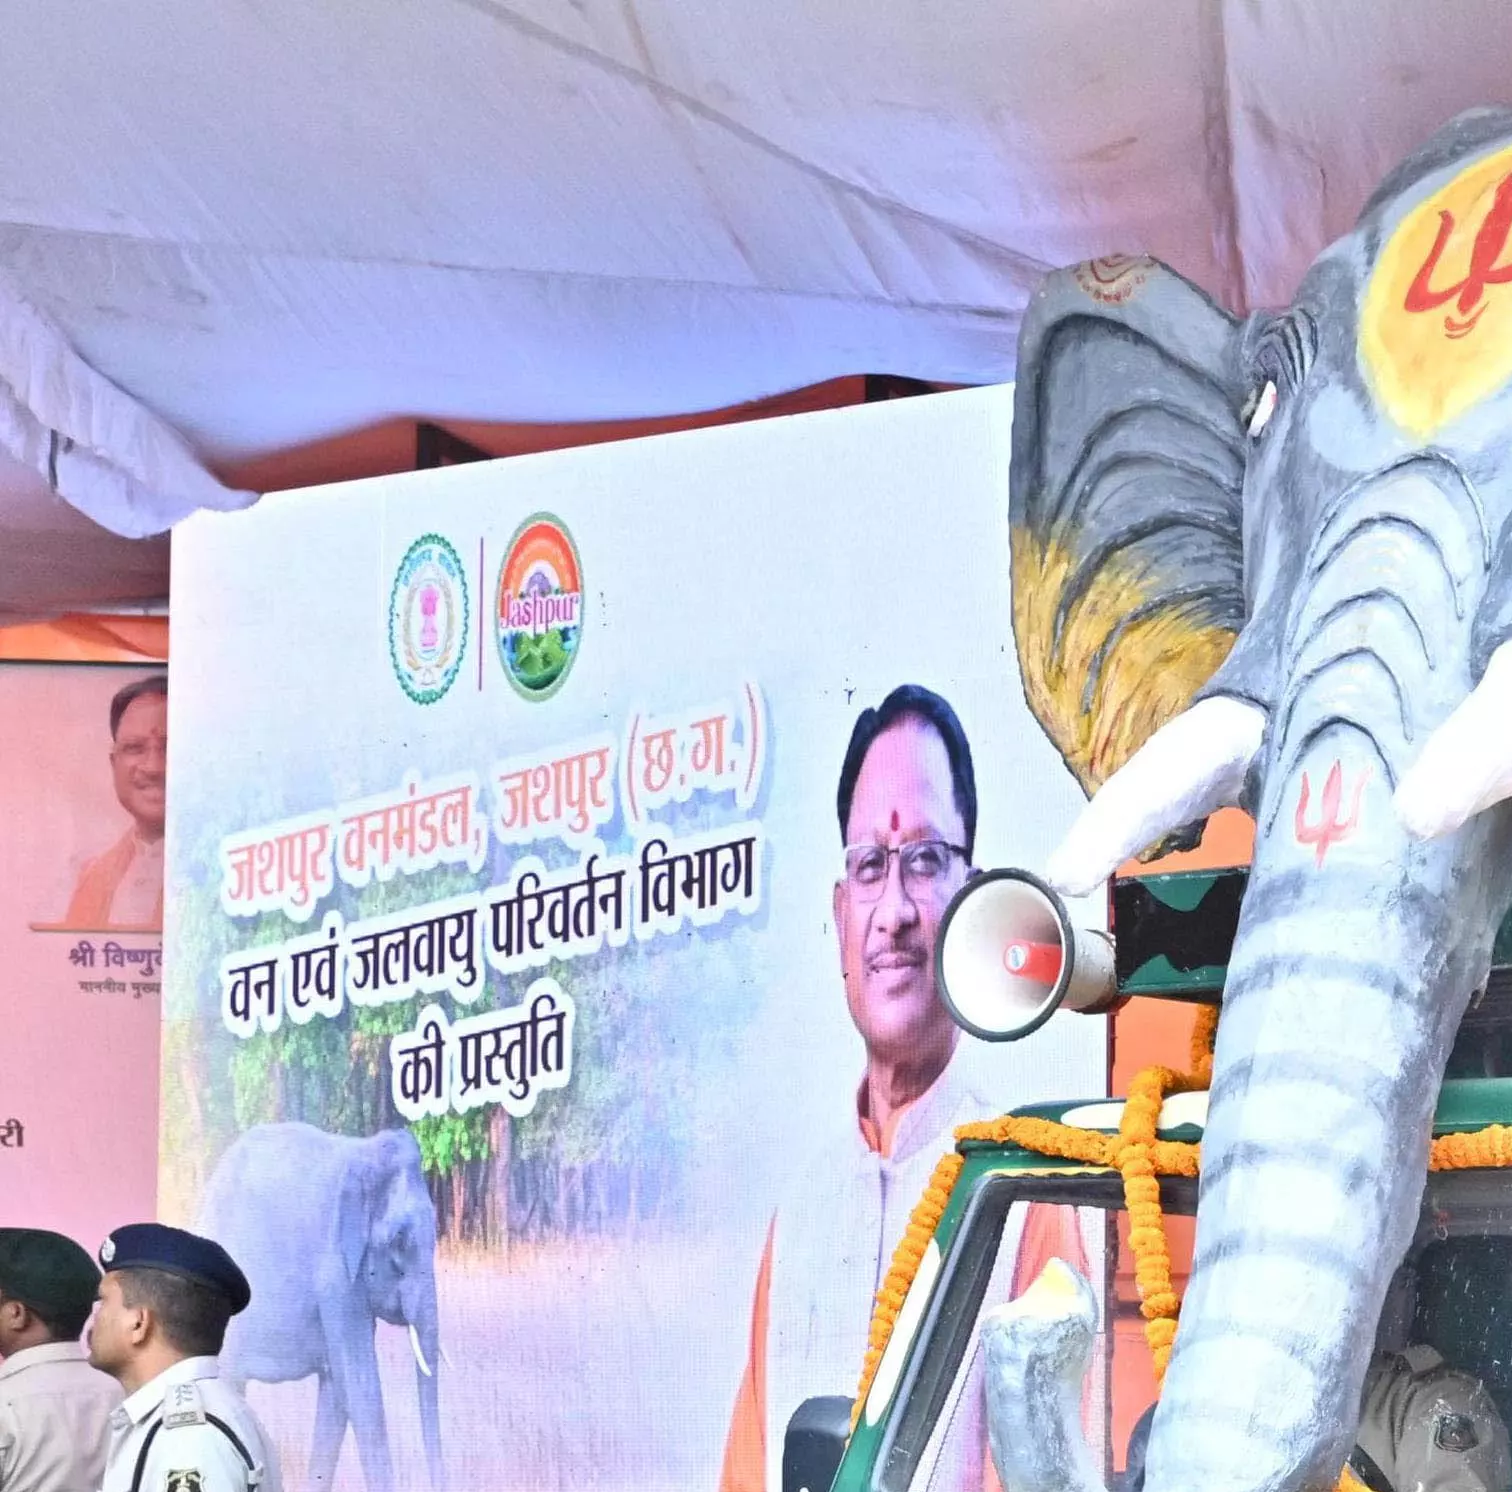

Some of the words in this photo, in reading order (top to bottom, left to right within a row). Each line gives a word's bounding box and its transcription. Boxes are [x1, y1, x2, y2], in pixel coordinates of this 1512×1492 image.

[500, 589, 578, 640] Jashpur
[228, 823, 330, 907] जशपुर
[343, 782, 483, 873] वनमंडल,
[499, 746, 610, 833] जशपुर
[627, 683, 758, 821] (छ.ग.)
[69, 940, 95, 967] श्री
[229, 957, 277, 1022] वन
[291, 927, 337, 1007] एवं
[352, 908, 478, 992] जलवायु
[491, 853, 625, 958] परिवर्तन
[640, 837, 757, 922] विभाग
[399, 1021, 444, 1104] की
[459, 994, 566, 1100] प्रस्तुति
